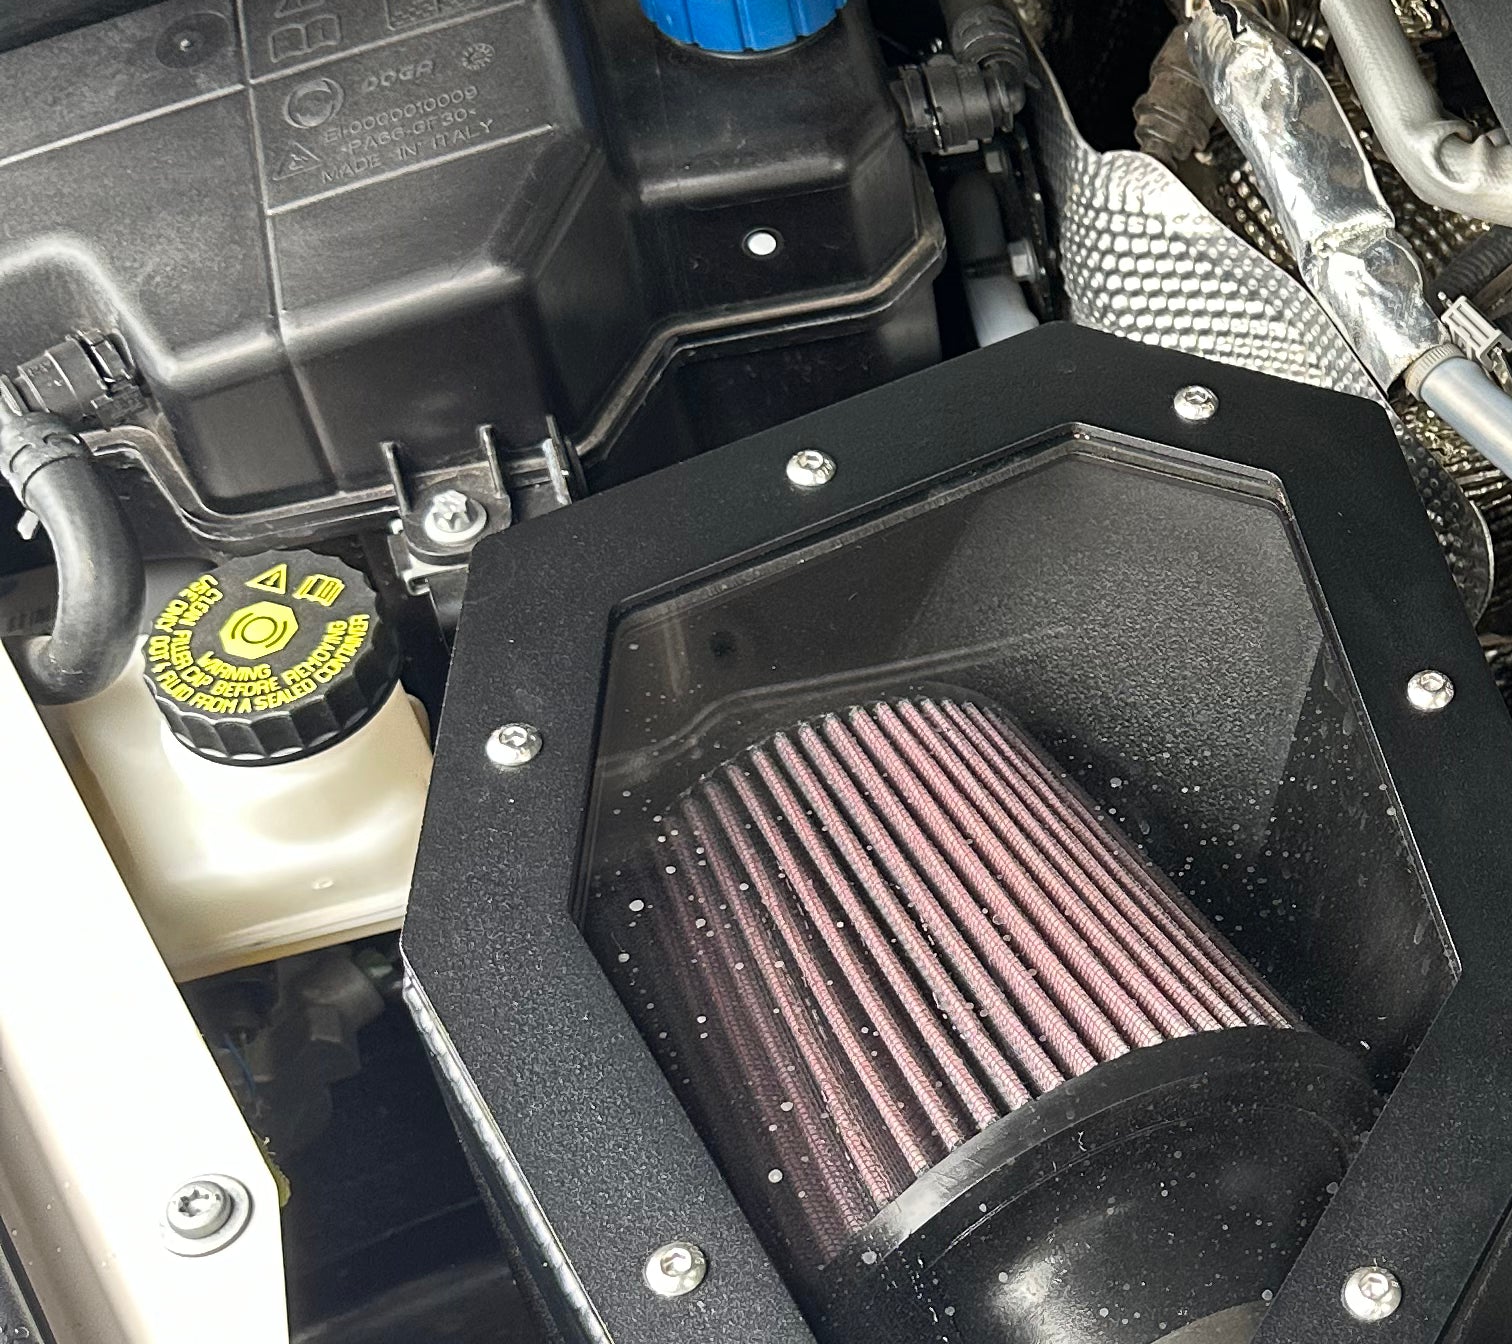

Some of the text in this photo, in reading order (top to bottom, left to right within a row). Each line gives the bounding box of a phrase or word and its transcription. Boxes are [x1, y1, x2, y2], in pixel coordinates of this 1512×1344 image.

[320, 117, 495, 185] MADE IN ITALY
[179, 573, 220, 602] USE
[154, 598, 190, 633] ONLY
[147, 634, 172, 662] DOT
[179, 665, 214, 689] CAP
[210, 676, 282, 698] BEFORE
[280, 619, 349, 686] REMOVING
[315, 613, 371, 685] CONTAINER
[196, 650, 272, 682] WARNING
[155, 668, 196, 703] FLUID
[252, 679, 319, 712] SEALED
[189, 691, 239, 714] FROM
[237, 695, 252, 714] A
